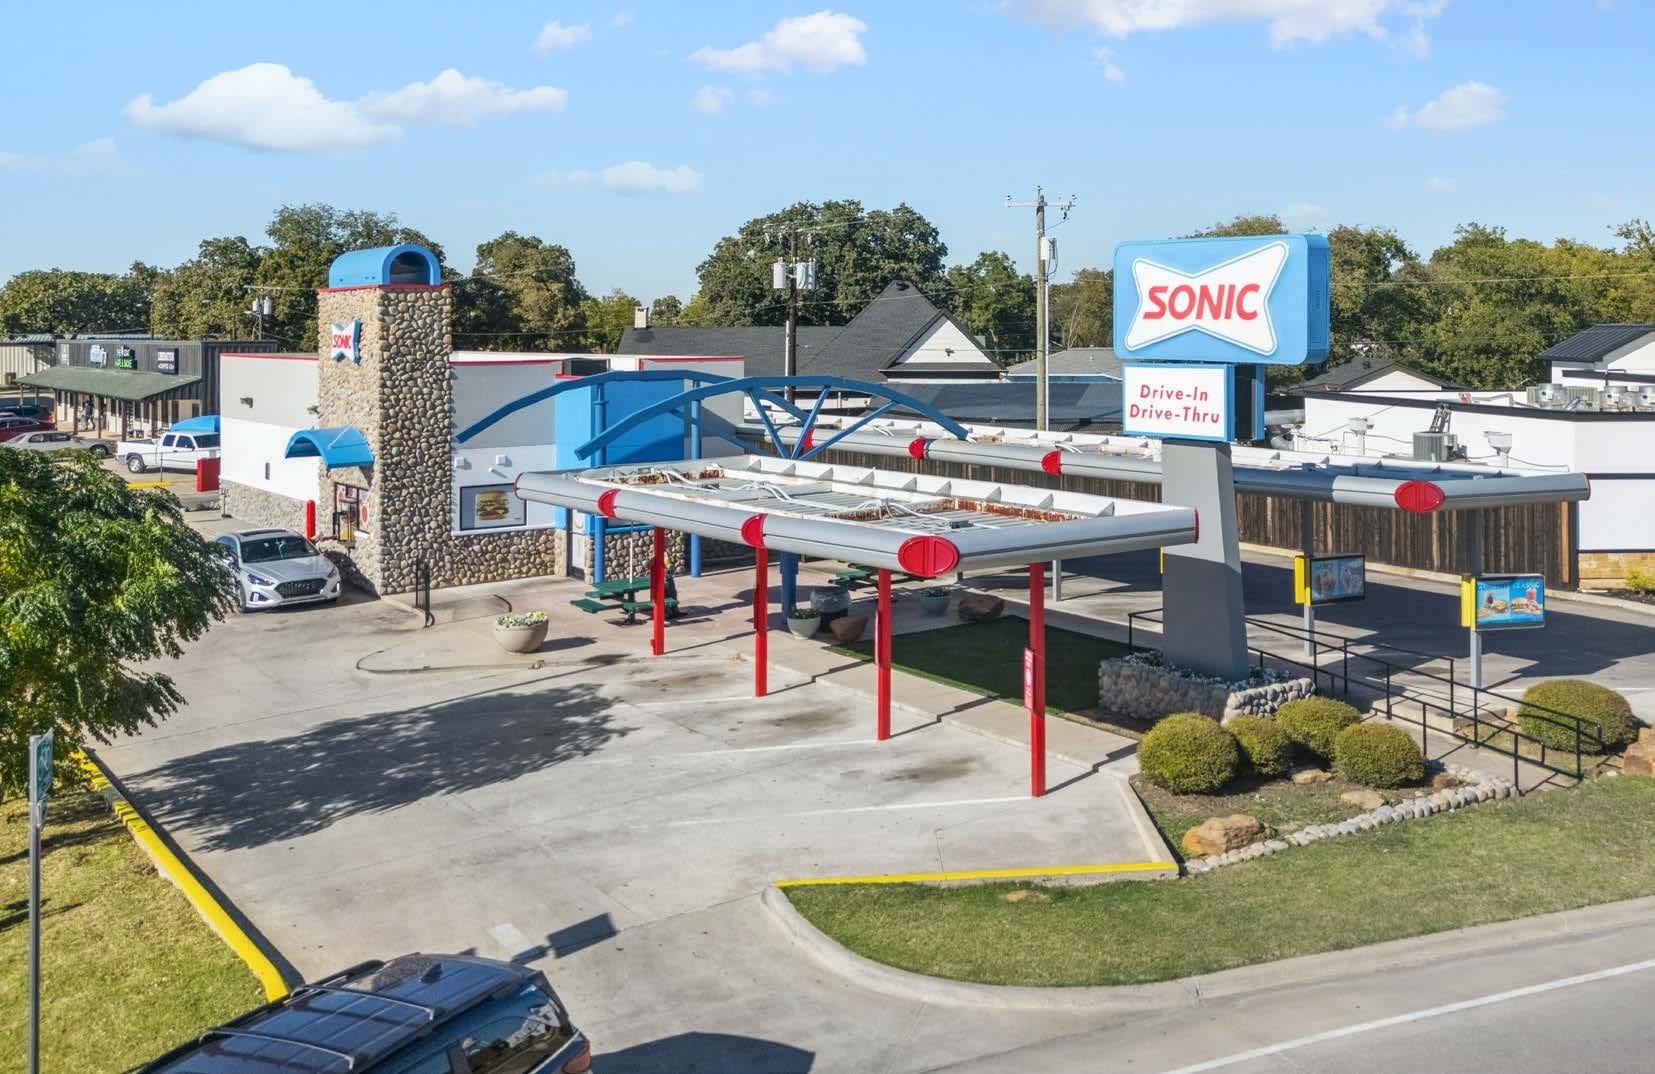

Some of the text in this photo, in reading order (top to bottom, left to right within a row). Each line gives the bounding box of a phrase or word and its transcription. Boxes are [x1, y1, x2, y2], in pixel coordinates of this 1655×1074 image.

[1142, 284, 1261, 321] SONIC
[1139, 384, 1209, 402] Drive-In
[1129, 404, 1220, 424] Drive-Thru
